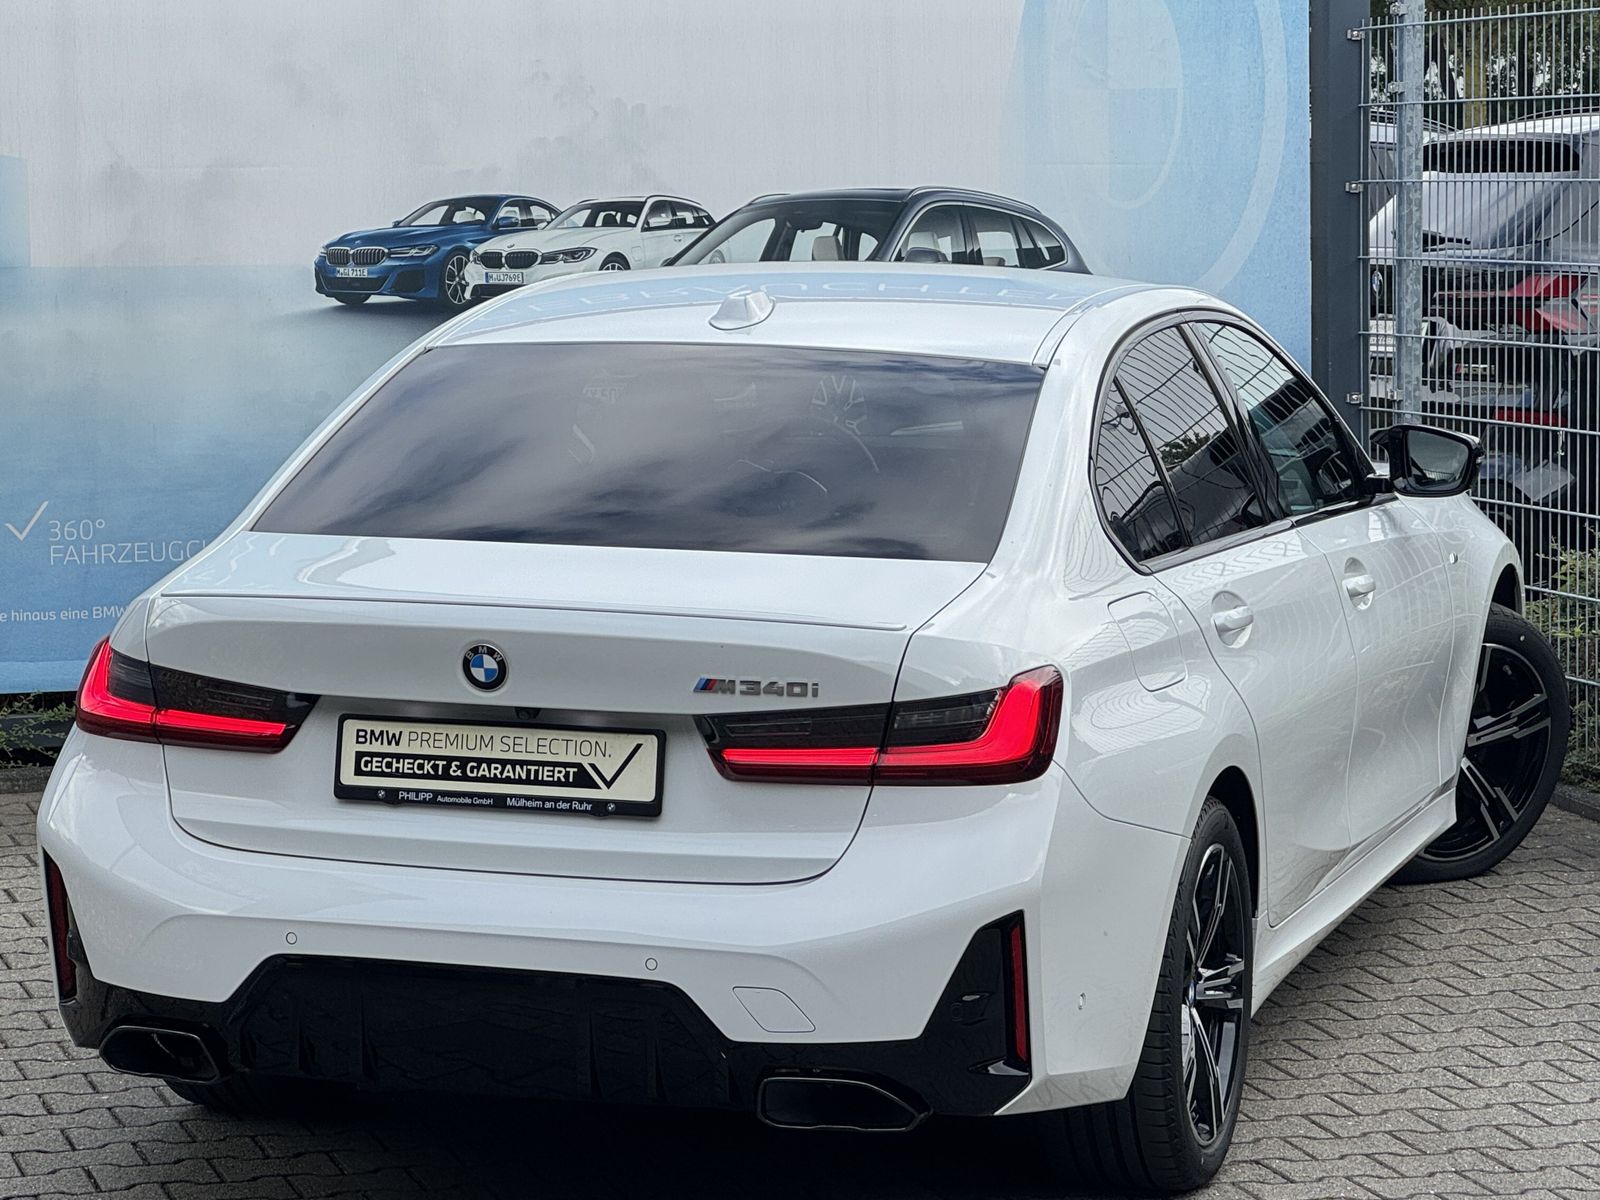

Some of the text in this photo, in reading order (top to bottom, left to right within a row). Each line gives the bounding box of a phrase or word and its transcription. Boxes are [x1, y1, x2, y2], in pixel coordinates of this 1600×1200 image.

[48, 519, 106, 541] 360°
[50, 540, 206, 565] FAHRZEUGC
[11, 609, 57, 622] hinaus
[60, 608, 89, 620] eine
[465, 645, 503, 662] BMW
[711, 679, 819, 698] M340i
[355, 728, 612, 758] BMW PREMIUM SELECTION.
[360, 756, 578, 783] GECHECKT & GARANTIERT
[398, 790, 494, 806] PHILIPP Automobile GmbH
[506, 797, 593, 811] Mülheim an der Ruhr
